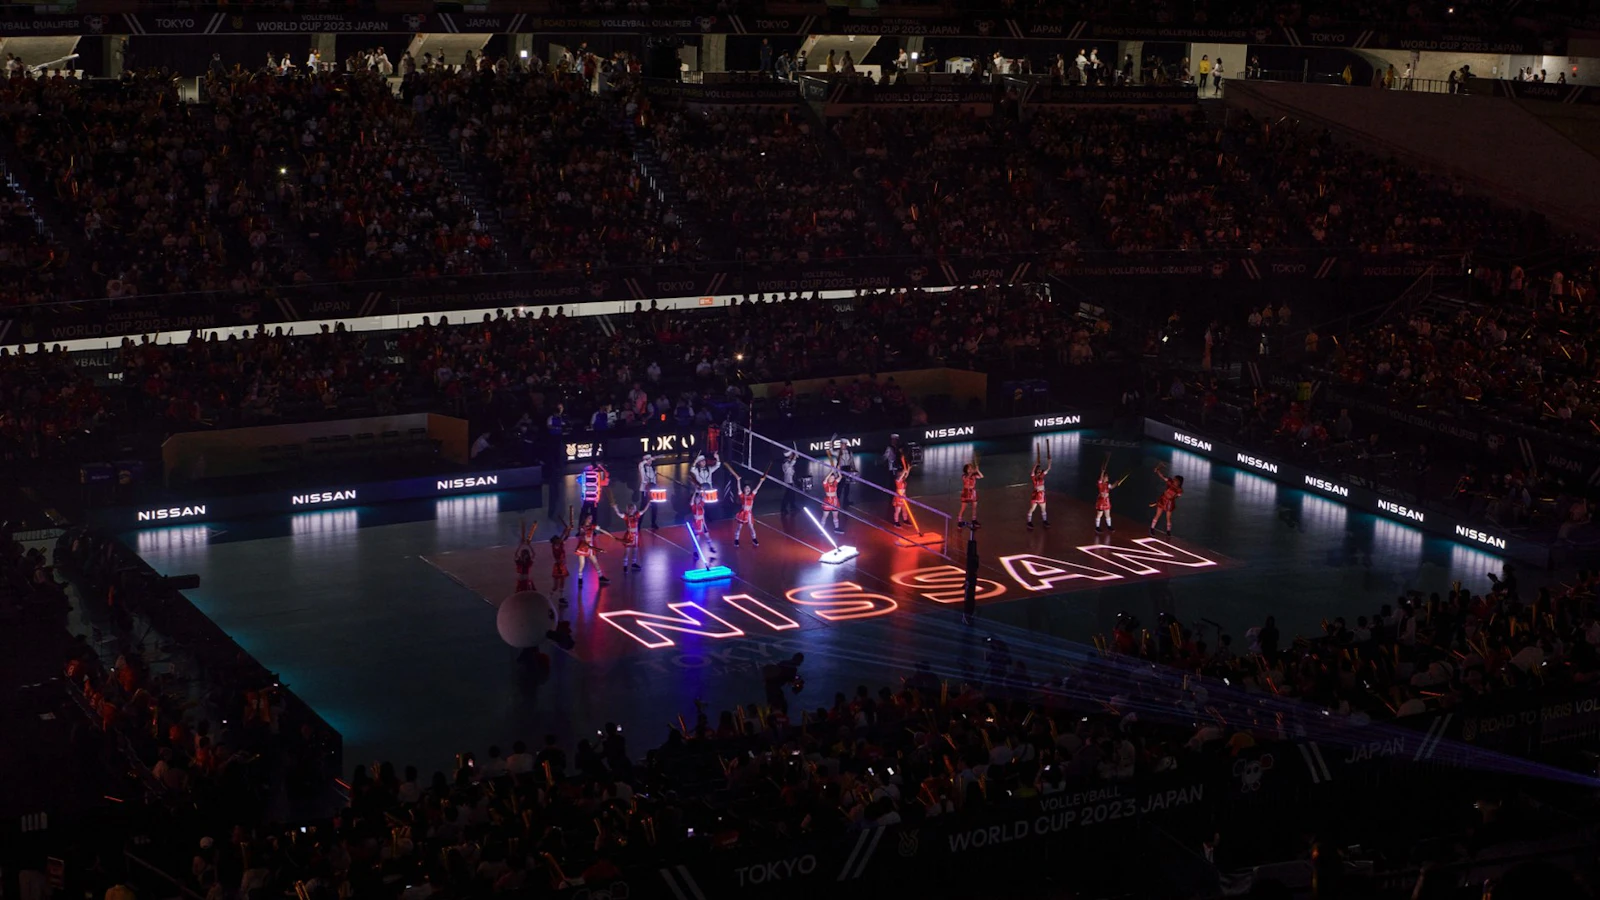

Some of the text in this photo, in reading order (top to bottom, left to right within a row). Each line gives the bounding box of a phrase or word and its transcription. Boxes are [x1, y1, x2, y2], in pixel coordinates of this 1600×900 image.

[0, 19, 80, 31] YBALL QUALIFIER
[155, 18, 195, 29] TOKYO
[256, 22, 388, 31] WORLD CUP 2023 JAPAN
[465, 18, 500, 28] JAPAN
[543, 19, 692, 27] ROAD TO PARIS VOLLEYBALL QUALIFIER
[755, 19, 790, 29] TOKYO
[842, 24, 960, 34] WORLD CUP 2023 JAPAN
[1029, 24, 1062, 34] JAPAN
[1103, 27, 1123, 35] ROAD
[1159, 28, 1204, 37] VOLLEYBALL
[1207, 29, 1247, 38] QUALIFIER
[1310, 32, 1345, 43] TOKYO
[1400, 40, 1523, 52] WORLD CUP 2023 JAPAN
[705, 90, 755, 98] VOLLEYBALL
[757, 90, 798, 98] QUALIFIER
[873, 92, 992, 102] WORLD CUP 2023 JAPAN
[1108, 90, 1156, 98] VOLLEYBALL
[1157, 91, 1195, 99] QUALIFIER
[1524, 85, 1558, 97] JAPAN
[802, 270, 844, 278] VOLLEYBALL
[969, 269, 1004, 280] JAPAN
[1108, 267, 1160, 276] VOLLEYBALL
[1271, 263, 1307, 274] TOKYO
[1363, 266, 1401, 276] WORLD
[1403, 266, 1424, 276] CUP
[656, 280, 695, 292] TOKYO
[756, 276, 890, 290] WORLD CUP 2023 JAPAN
[472, 288, 531, 302] VOLLEYBALL
[533, 285, 581, 297] QUALIFIER
[308, 300, 351, 313] JAPAN
[106, 311, 161, 321] VOLLEYBALL
[51, 314, 215, 338] WORLD CUP 2023 JAPAN
[1034, 415, 1081, 428] NISSAN
[1389, 407, 1437, 432] VOLLEYBALL
[1438, 422, 1479, 443] QUALIFIER
[925, 426, 974, 439] NISSAN
[640, 434, 695, 452] TOKO
[1174, 432, 1212, 452] NISSAN
[1237, 452, 1278, 474] NISSAN
[1545, 452, 1583, 474] JAPAN
[437, 475, 498, 490] NISSAN
[1305, 475, 1349, 497] NISSAN
[292, 489, 357, 505] NISSAN
[137, 504, 206, 522] NISSAN
[1377, 498, 1424, 522] NISSAN
[1455, 524, 1506, 550] NISSAN
[597, 536, 1217, 650] NISSAN
[1479, 697, 1600, 736] ROAD TO PARIS VOL
[1345, 736, 1405, 764] JAPAN
[1039, 786, 1121, 813] VOLLEYBALL
[948, 784, 1204, 855] WORLD CUP 2023 JAPAN
[734, 852, 818, 888] TOKYO
